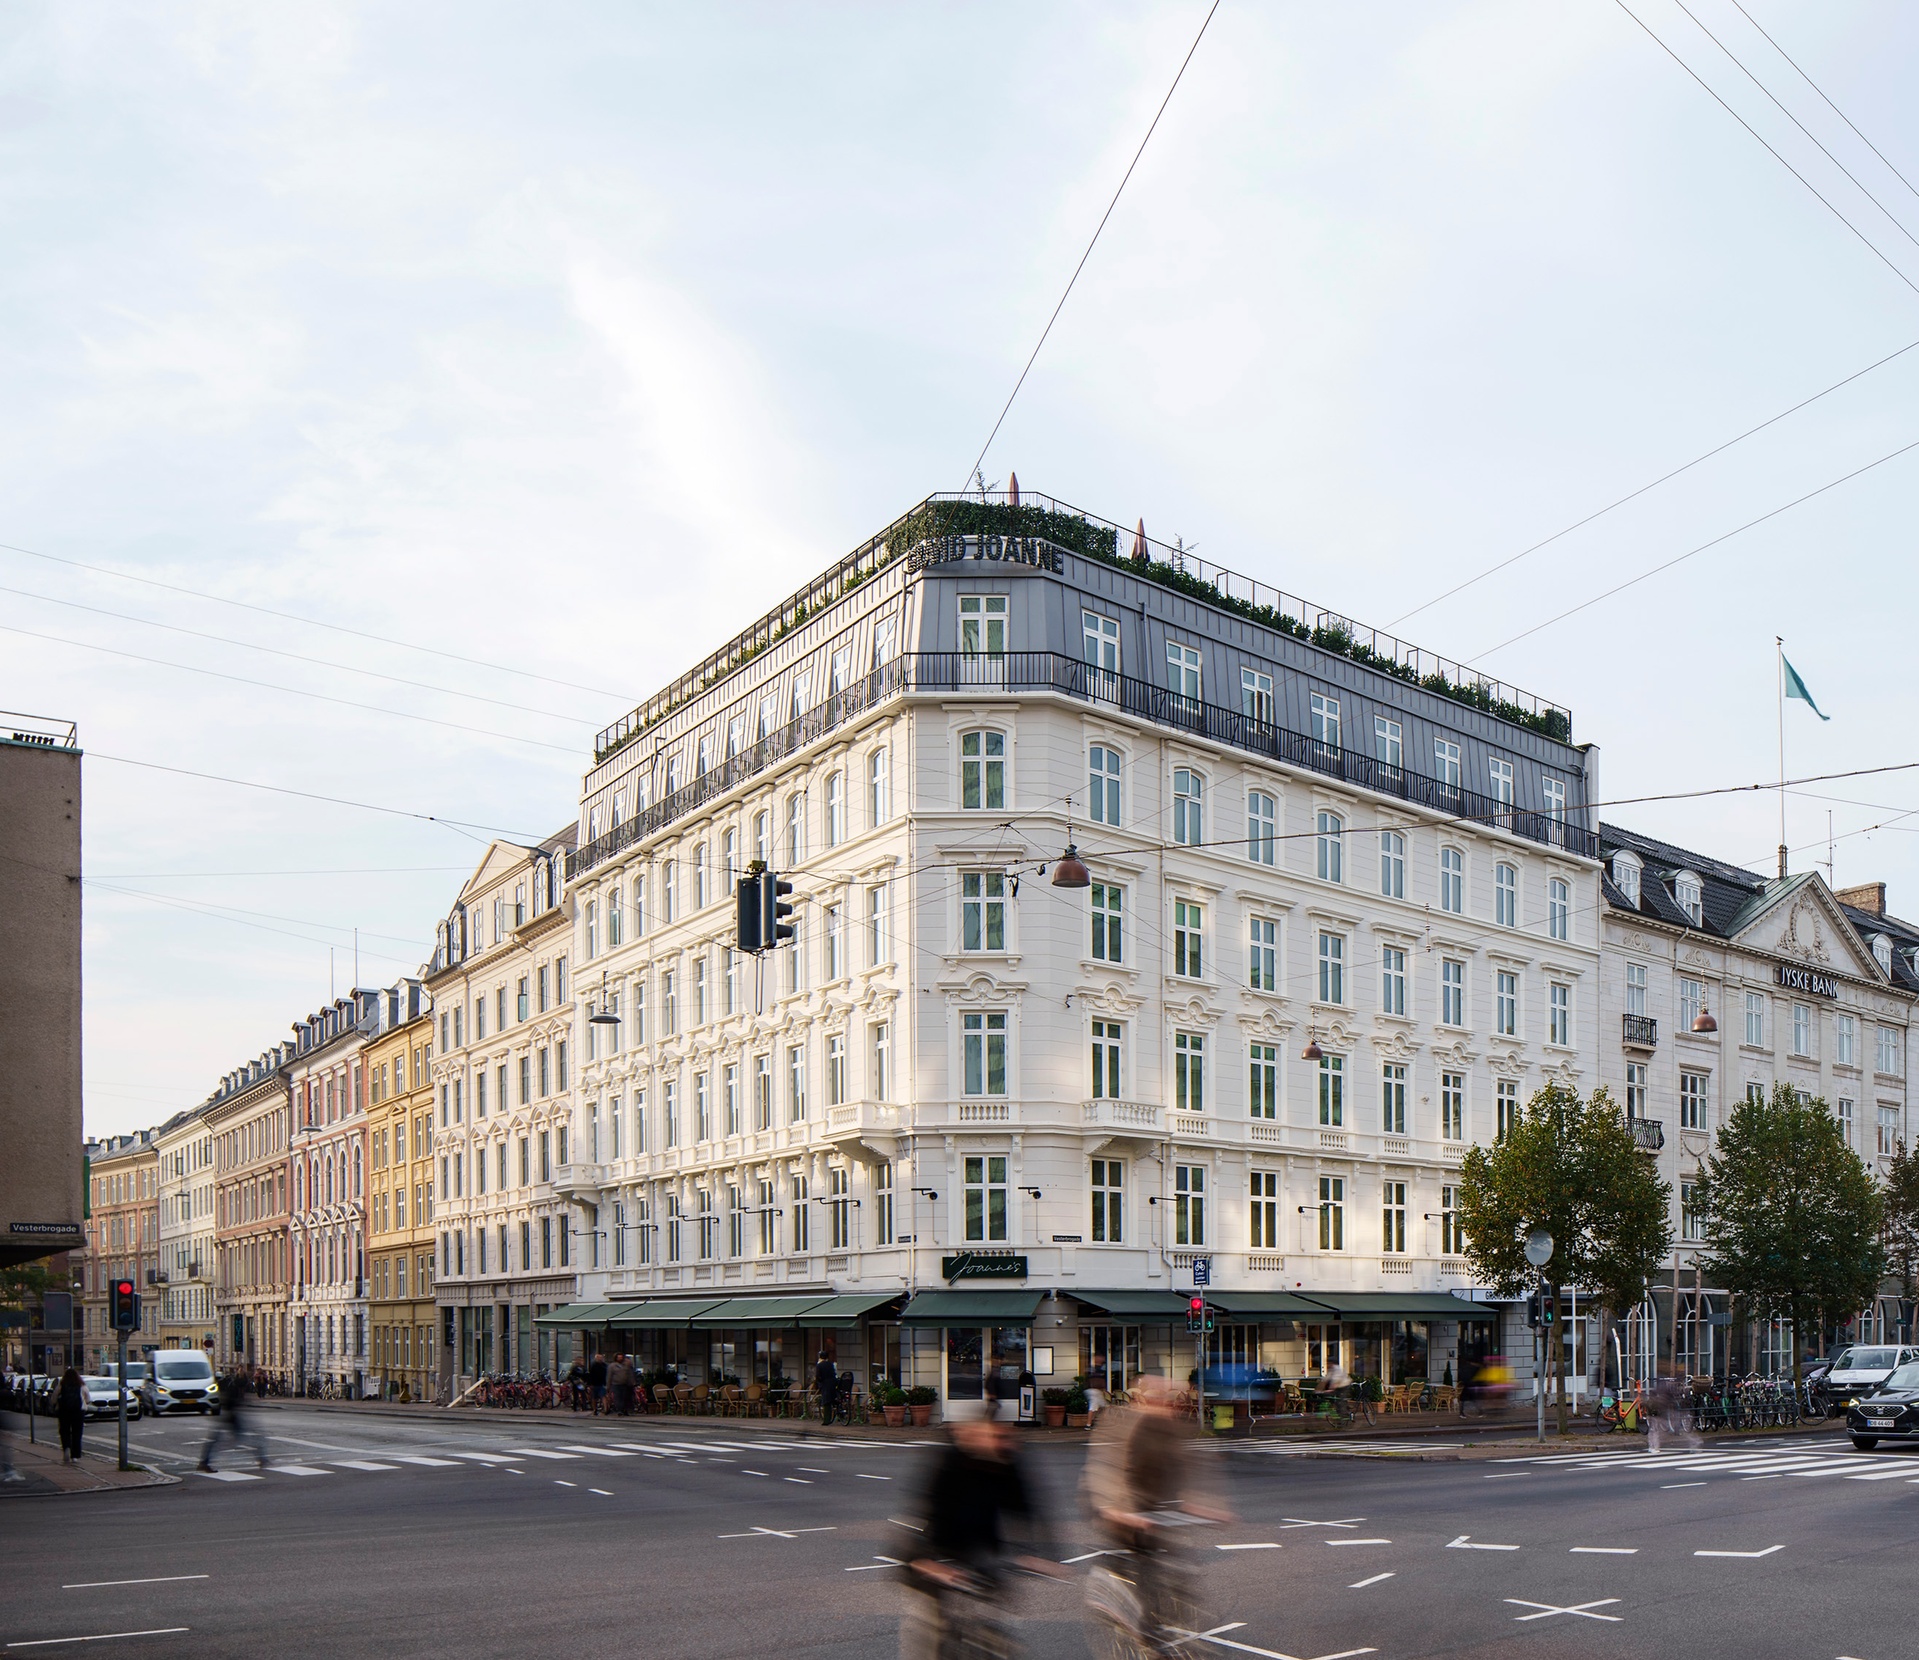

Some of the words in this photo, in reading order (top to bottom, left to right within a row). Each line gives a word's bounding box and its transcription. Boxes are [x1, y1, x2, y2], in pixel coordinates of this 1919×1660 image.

[973, 533, 1064, 576] JOANNE
[1781, 966, 1811, 991] JYSKE
[1812, 974, 1840, 998] BANK
[13, 1224, 77, 1233] Vesterbrogade
[948, 1251, 1021, 1286] Joanne's
